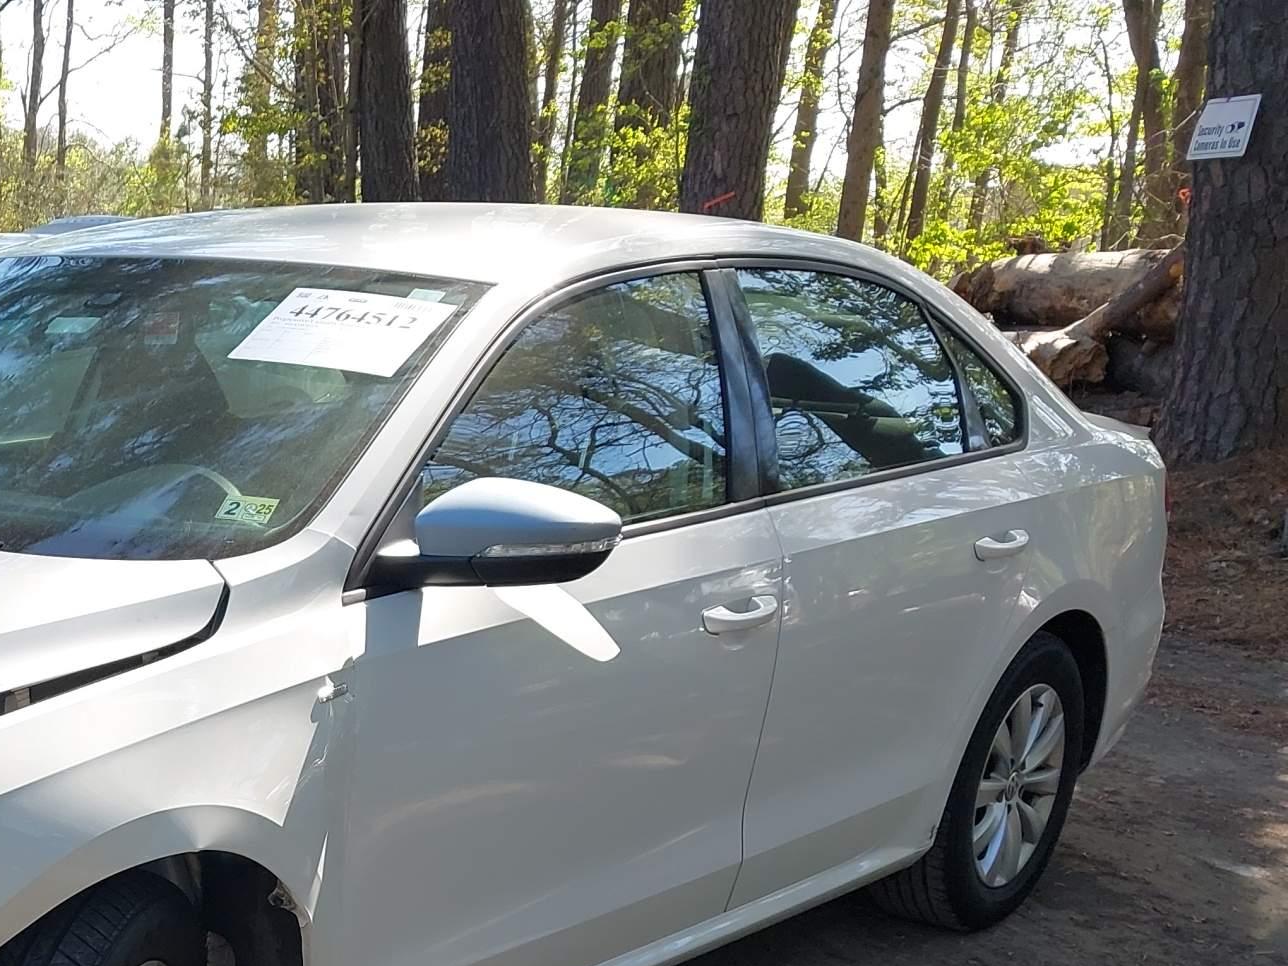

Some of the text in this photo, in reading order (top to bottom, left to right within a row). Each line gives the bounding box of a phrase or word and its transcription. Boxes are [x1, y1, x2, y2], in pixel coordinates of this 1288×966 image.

[1198, 125, 1223, 137] Security
[1194, 140, 1219, 151] Cameras
[1228, 137, 1240, 148] Use
[289, 304, 418, 329] 44764512
[224, 502, 274, 515] 2 25
